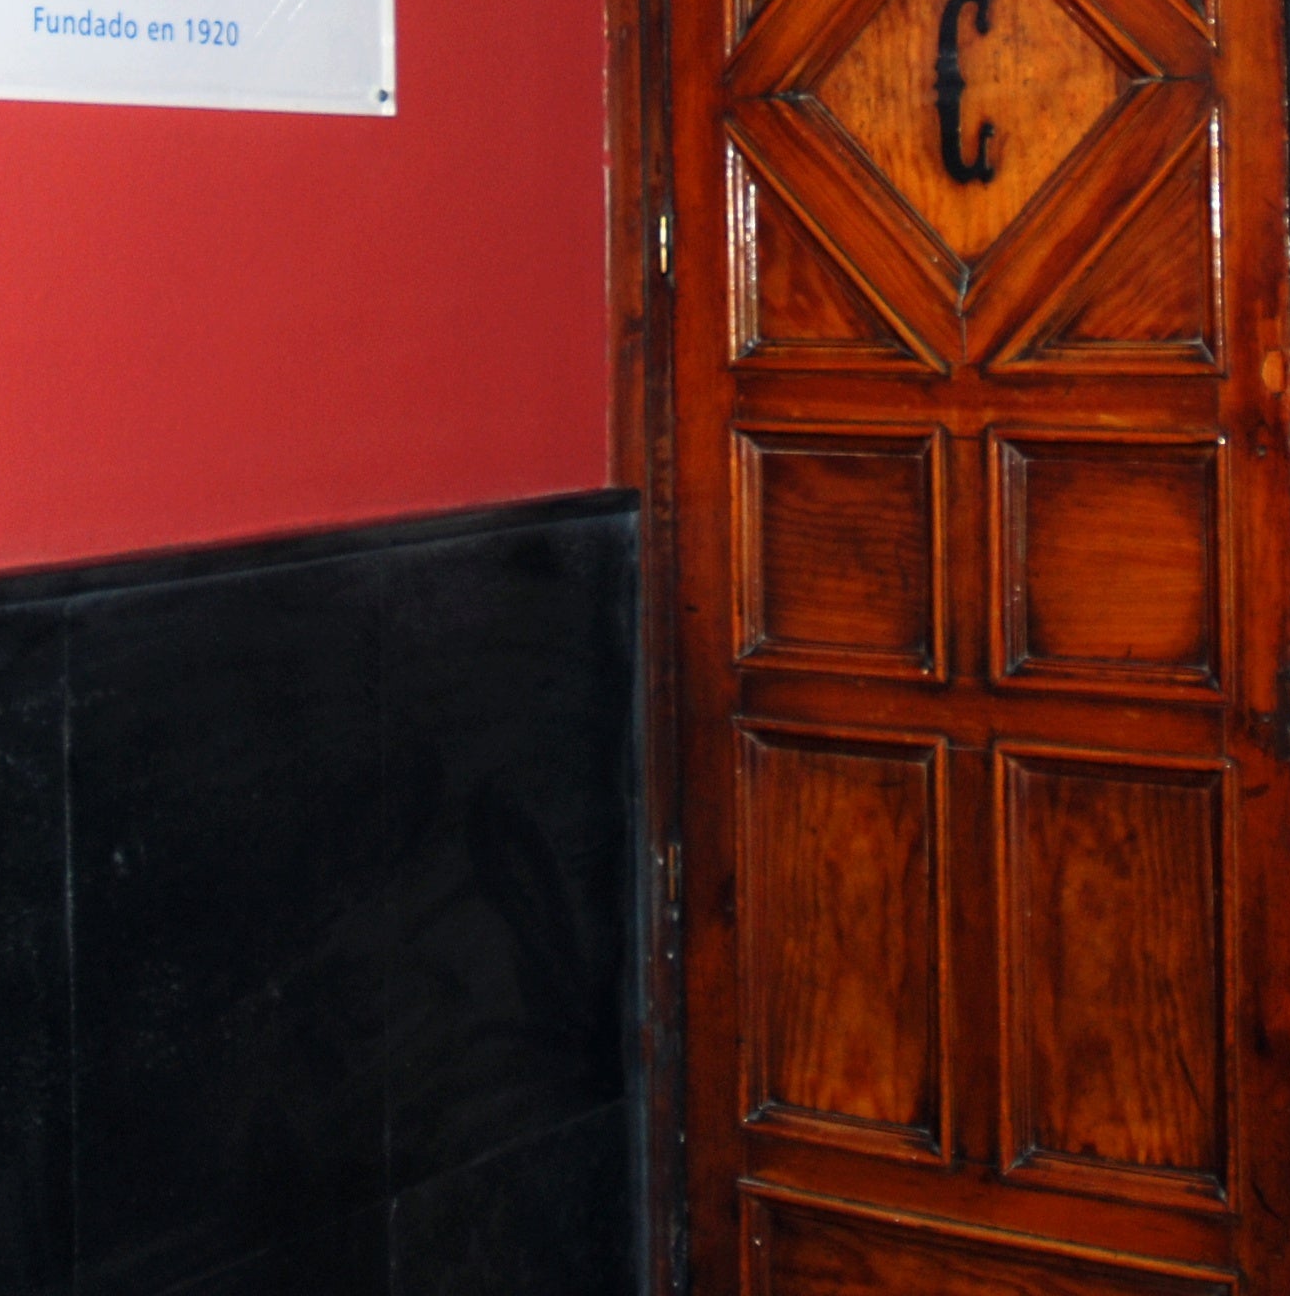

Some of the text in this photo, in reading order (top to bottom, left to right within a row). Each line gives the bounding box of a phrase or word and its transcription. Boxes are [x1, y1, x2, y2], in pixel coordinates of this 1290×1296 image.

[33, 7, 240, 46] Fundado en 1920
